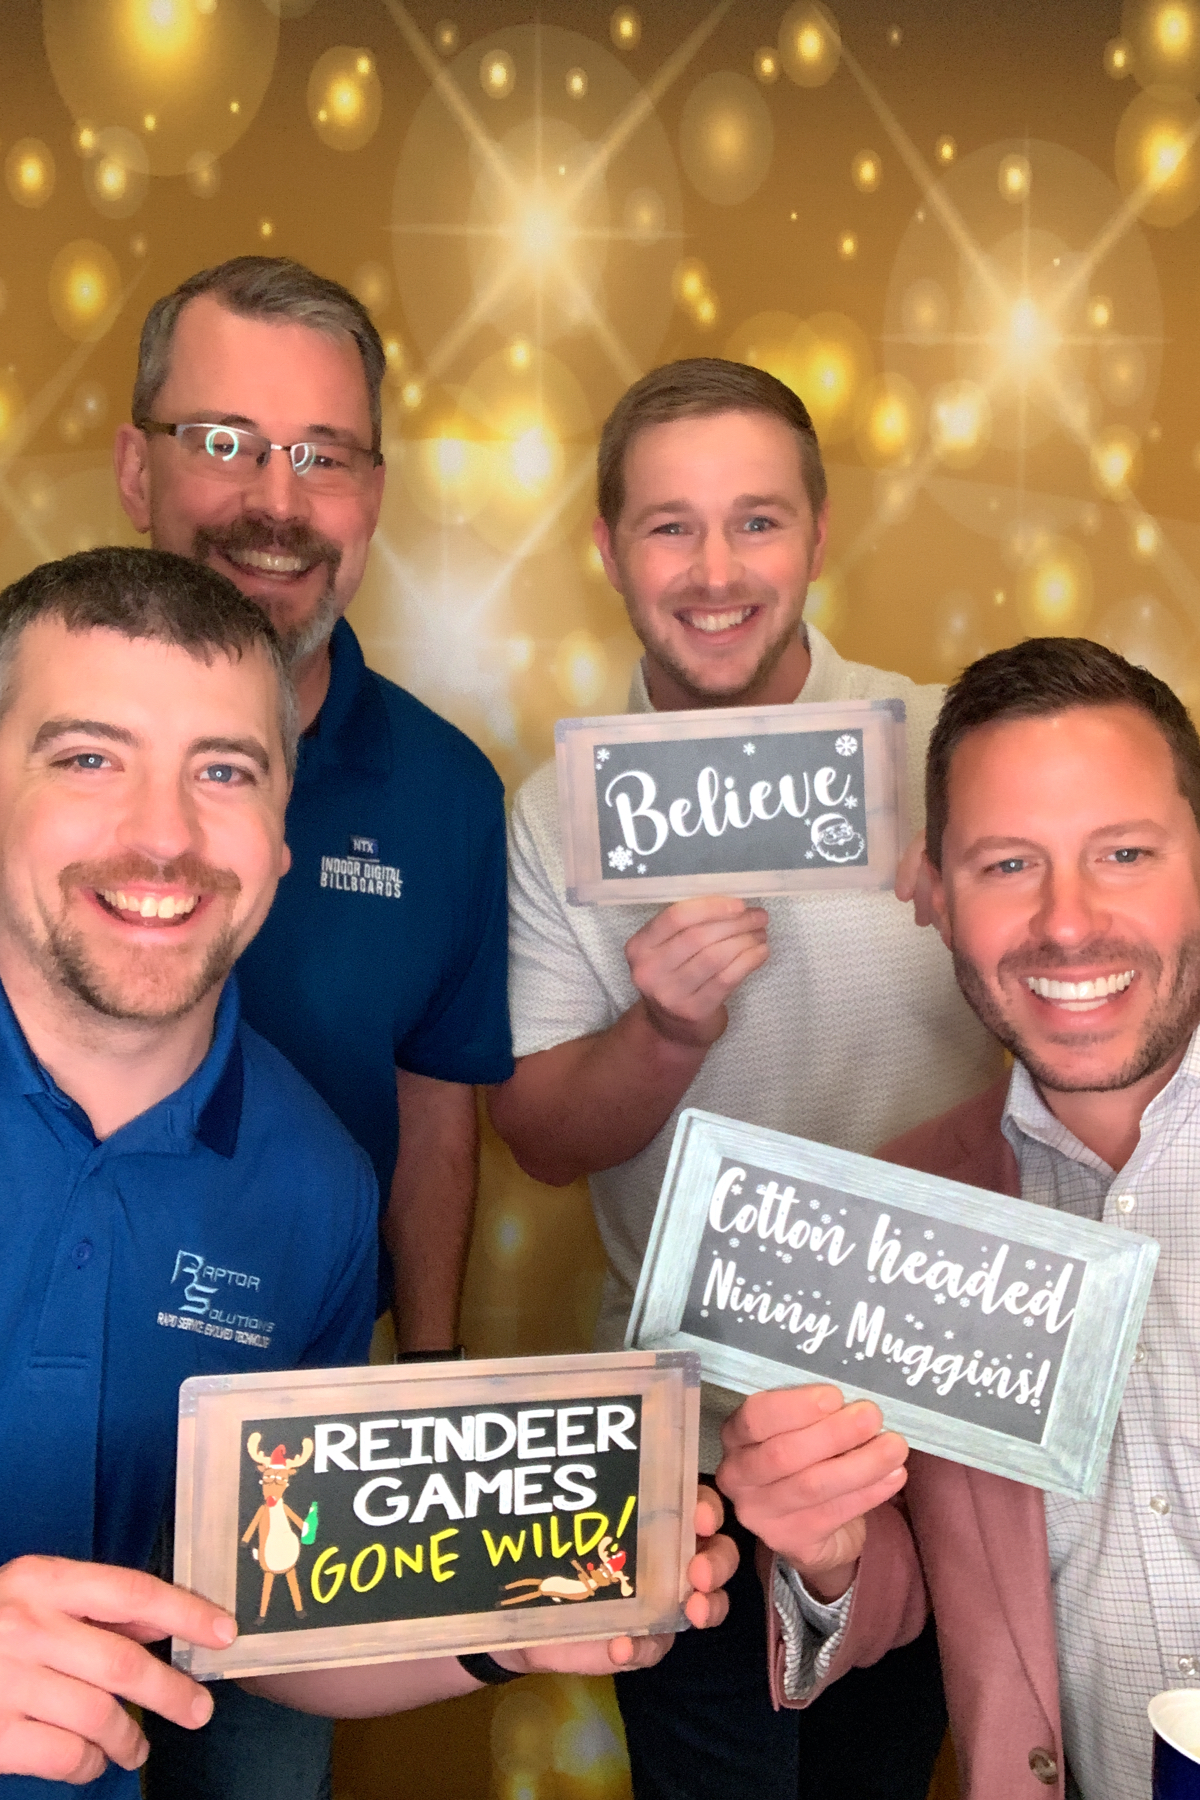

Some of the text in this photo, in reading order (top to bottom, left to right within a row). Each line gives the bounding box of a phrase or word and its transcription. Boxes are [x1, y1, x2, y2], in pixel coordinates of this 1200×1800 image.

[605, 766, 850, 856] Believe
[321, 856, 403, 884] INDOOR DIGITAL
[353, 839, 374, 854] NTX
[320, 872, 402, 899] BILLBOARDS
[708, 1167, 1076, 1334] Cotton headed
[702, 1258, 1051, 1407] Ninny Muggins!
[314, 1405, 637, 1474] REINDEER
[352, 1464, 598, 1527] GAMES
[310, 1496, 636, 1604] GONE WILD!
